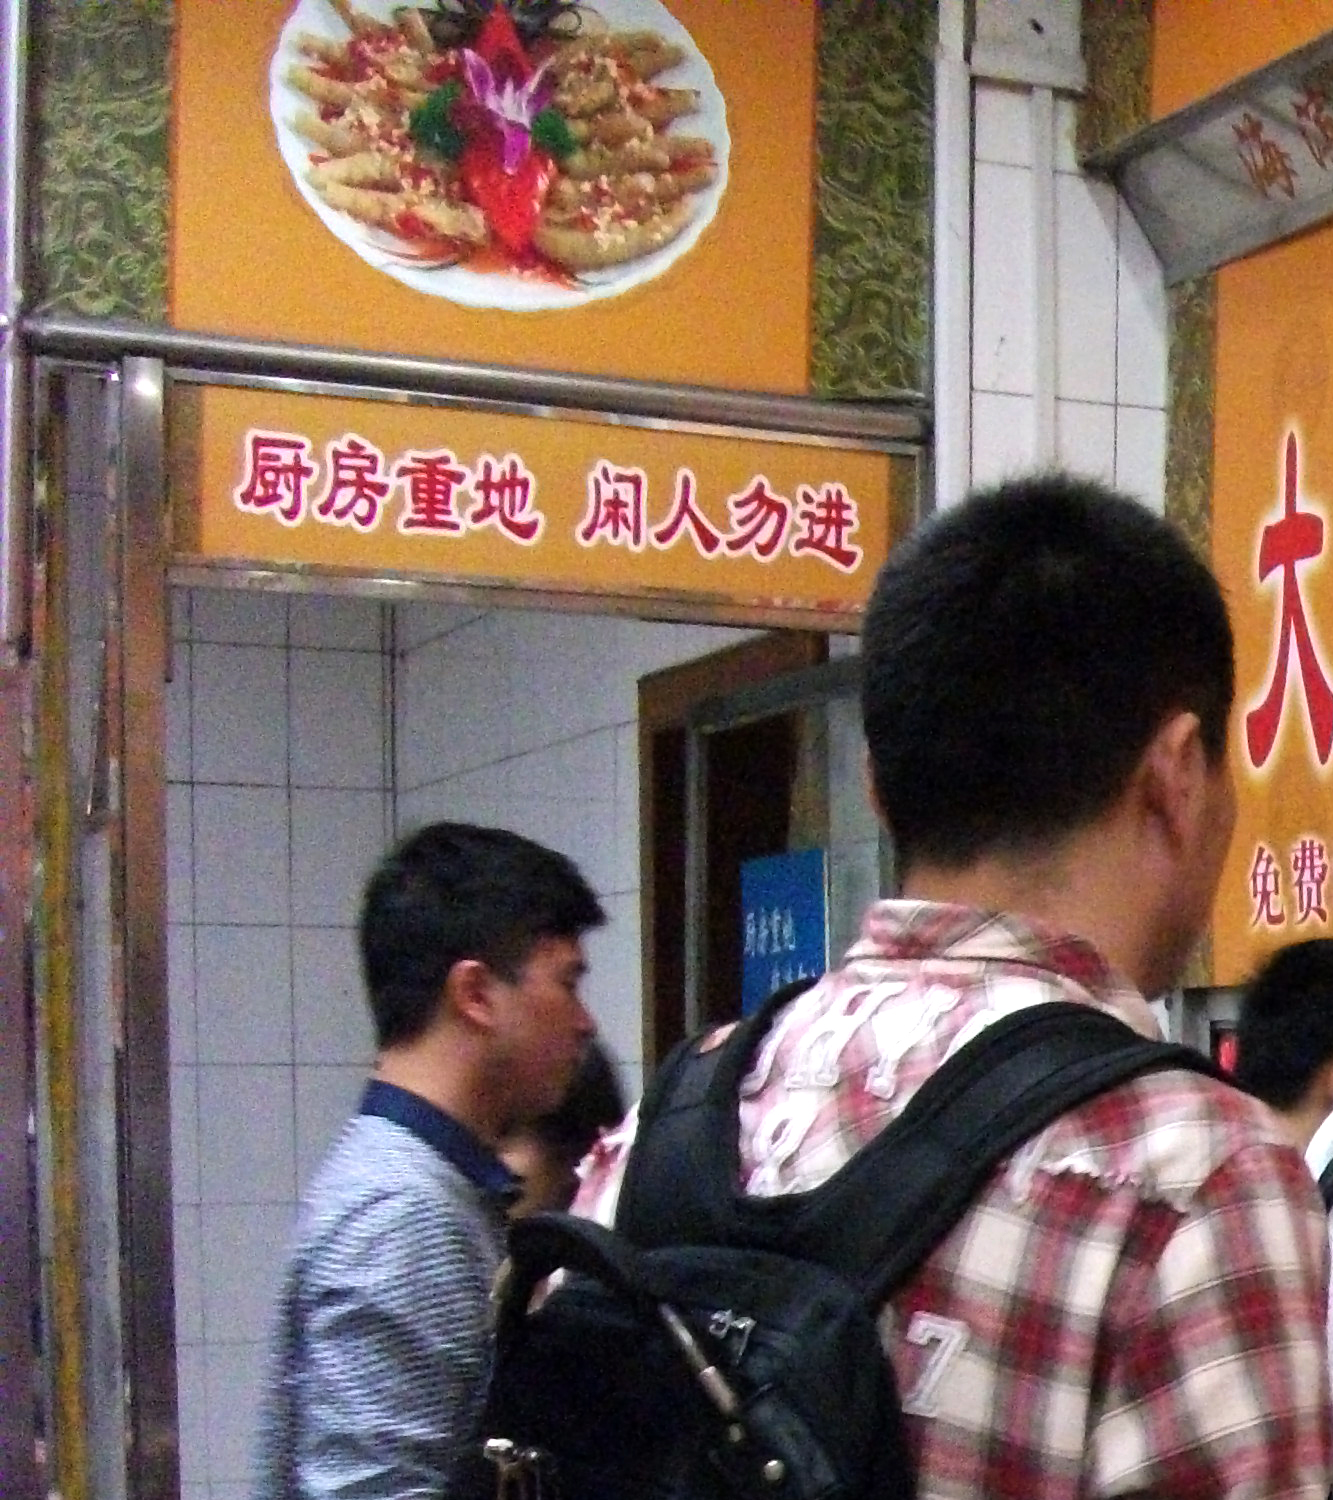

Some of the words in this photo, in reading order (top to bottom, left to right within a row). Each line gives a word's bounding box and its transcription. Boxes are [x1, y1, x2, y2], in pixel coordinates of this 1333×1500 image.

[240, 433, 541, 542] 厨房重地
[579, 464, 861, 568] 闲人勿进
